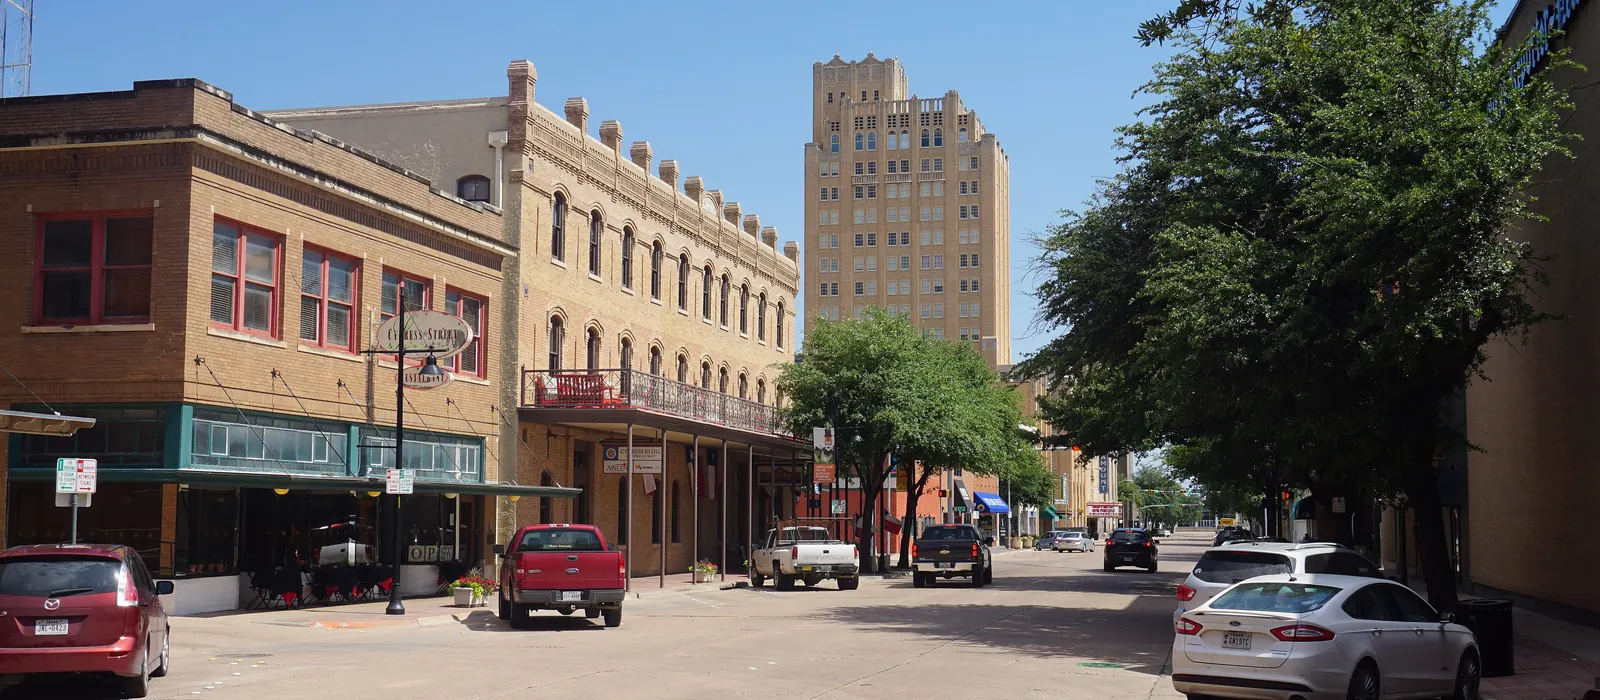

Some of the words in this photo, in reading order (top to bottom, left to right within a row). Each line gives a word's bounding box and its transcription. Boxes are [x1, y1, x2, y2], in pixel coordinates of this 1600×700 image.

[388, 328, 422, 340] CYRESS
[427, 327, 457, 340] STREET
[404, 373, 444, 383] ESTAURANT
